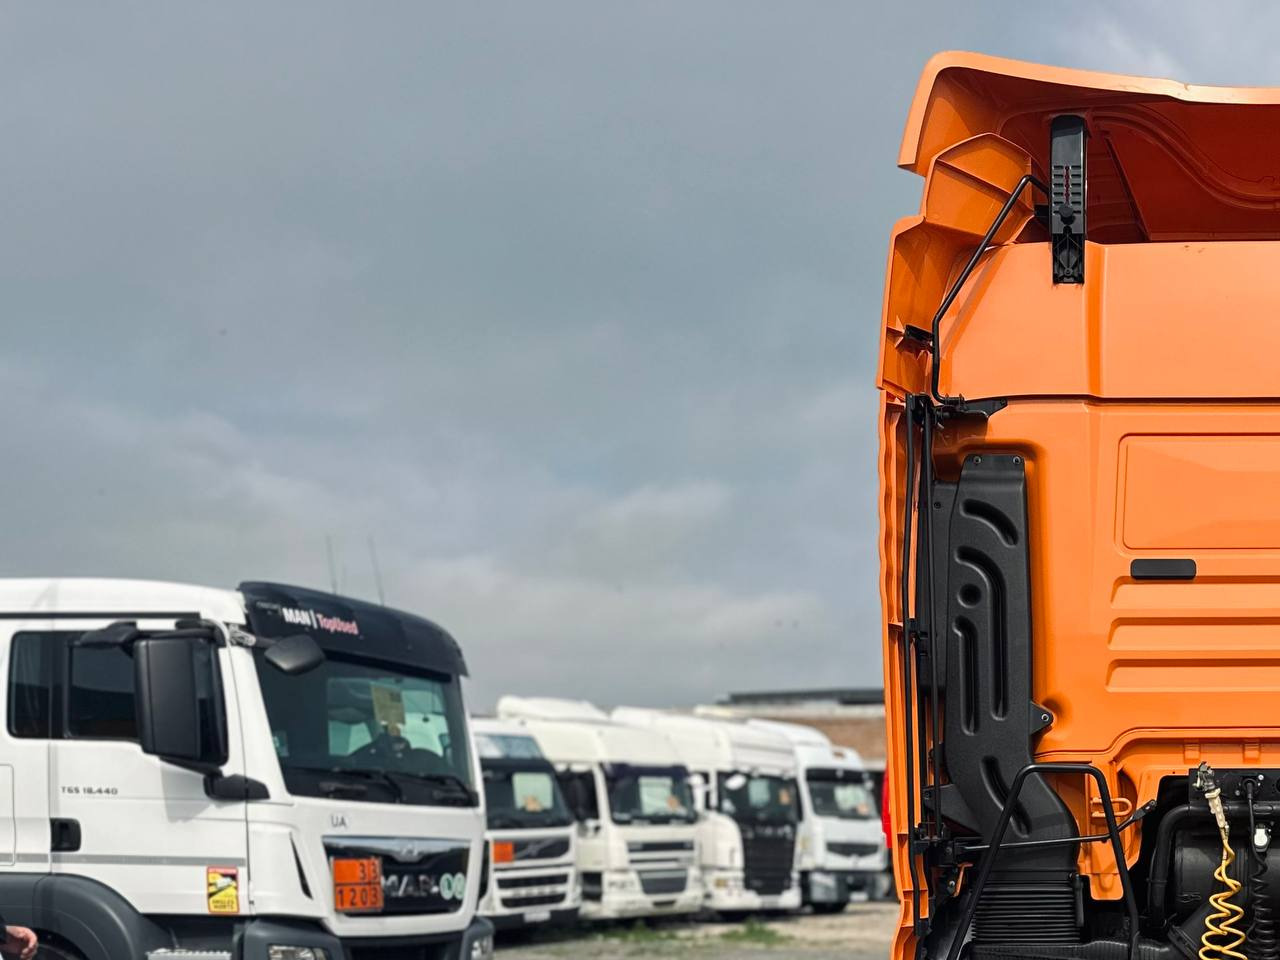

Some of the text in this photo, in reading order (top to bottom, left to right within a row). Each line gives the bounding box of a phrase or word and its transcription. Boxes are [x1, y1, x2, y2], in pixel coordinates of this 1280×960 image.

[282, 607, 311, 627] MAN
[331, 815, 347, 828] UA
[359, 860, 379, 881] 33
[338, 887, 379, 907] 1203
